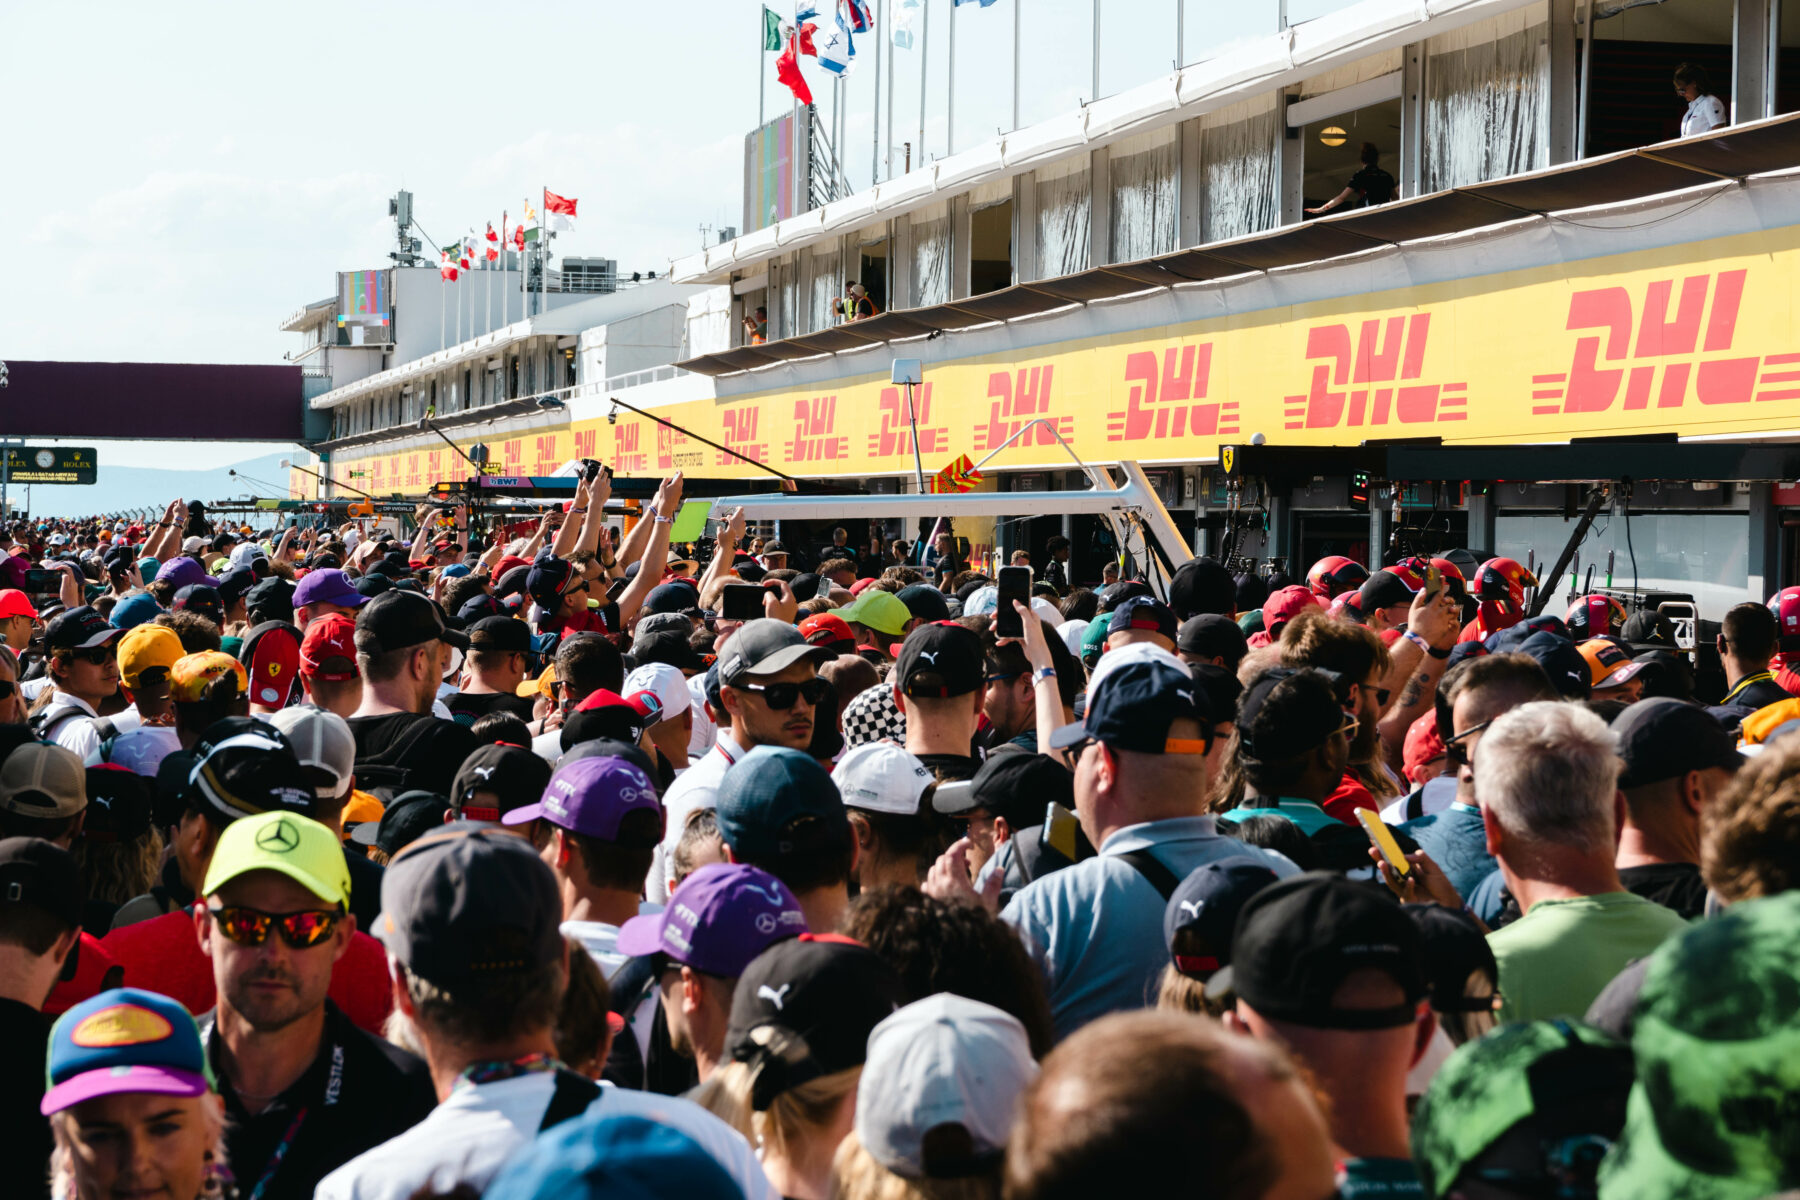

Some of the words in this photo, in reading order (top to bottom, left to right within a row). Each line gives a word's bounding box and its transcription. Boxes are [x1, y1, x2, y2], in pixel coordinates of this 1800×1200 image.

[1306, 314, 1440, 428] DHL
[1564, 270, 1760, 412] DHL
[879, 382, 938, 461] DHL
[987, 365, 1060, 449] DHL
[1125, 344, 1219, 441] DHL
[537, 435, 559, 477] DHL
[615, 422, 641, 472] DHL
[722, 407, 761, 465] DHL
[793, 396, 838, 461] DHL
[497, 478, 519, 486] BWT
[1083, 643, 1098, 651] BOSS
